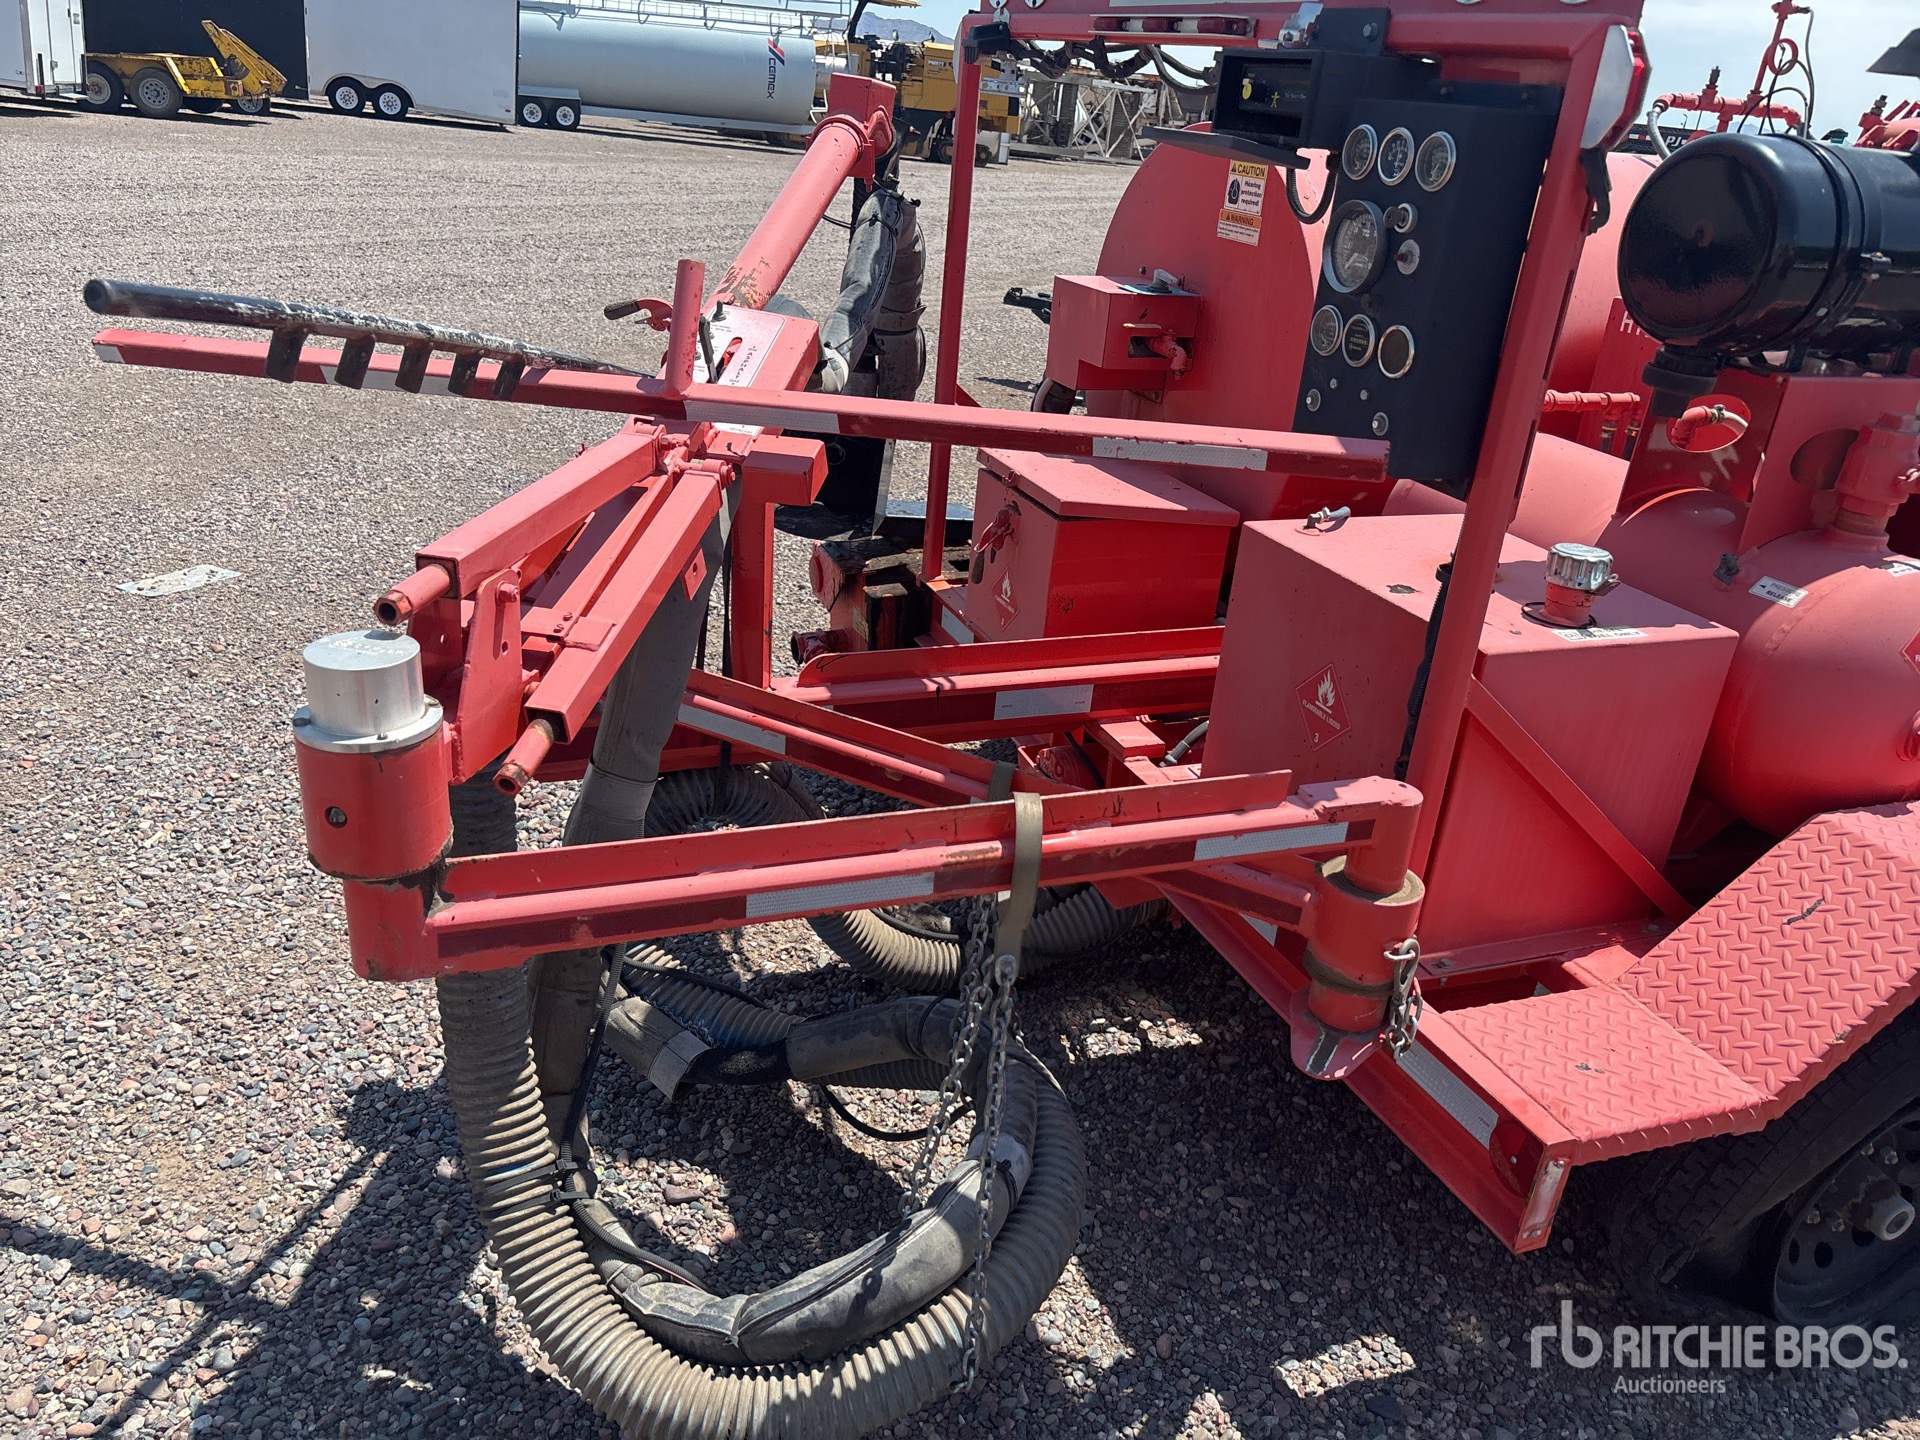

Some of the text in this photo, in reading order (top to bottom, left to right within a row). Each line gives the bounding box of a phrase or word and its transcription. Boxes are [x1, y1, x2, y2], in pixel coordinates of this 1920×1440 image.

[767, 57, 776, 99] CEMEX
[1665, 135, 1682, 147] PJ
[1237, 164, 1265, 177] CAUTION
[1244, 180, 1261, 190] Hearing
[1240, 189, 1262, 199] protection
[1230, 213, 1254, 226] WARNING
[735, 352, 753, 379] ASPHALT
[1766, 590, 1792, 602] RELEASE
[1302, 699, 1341, 730] FLAMMABLE LIQUID
[1313, 732, 1320, 743] 3
